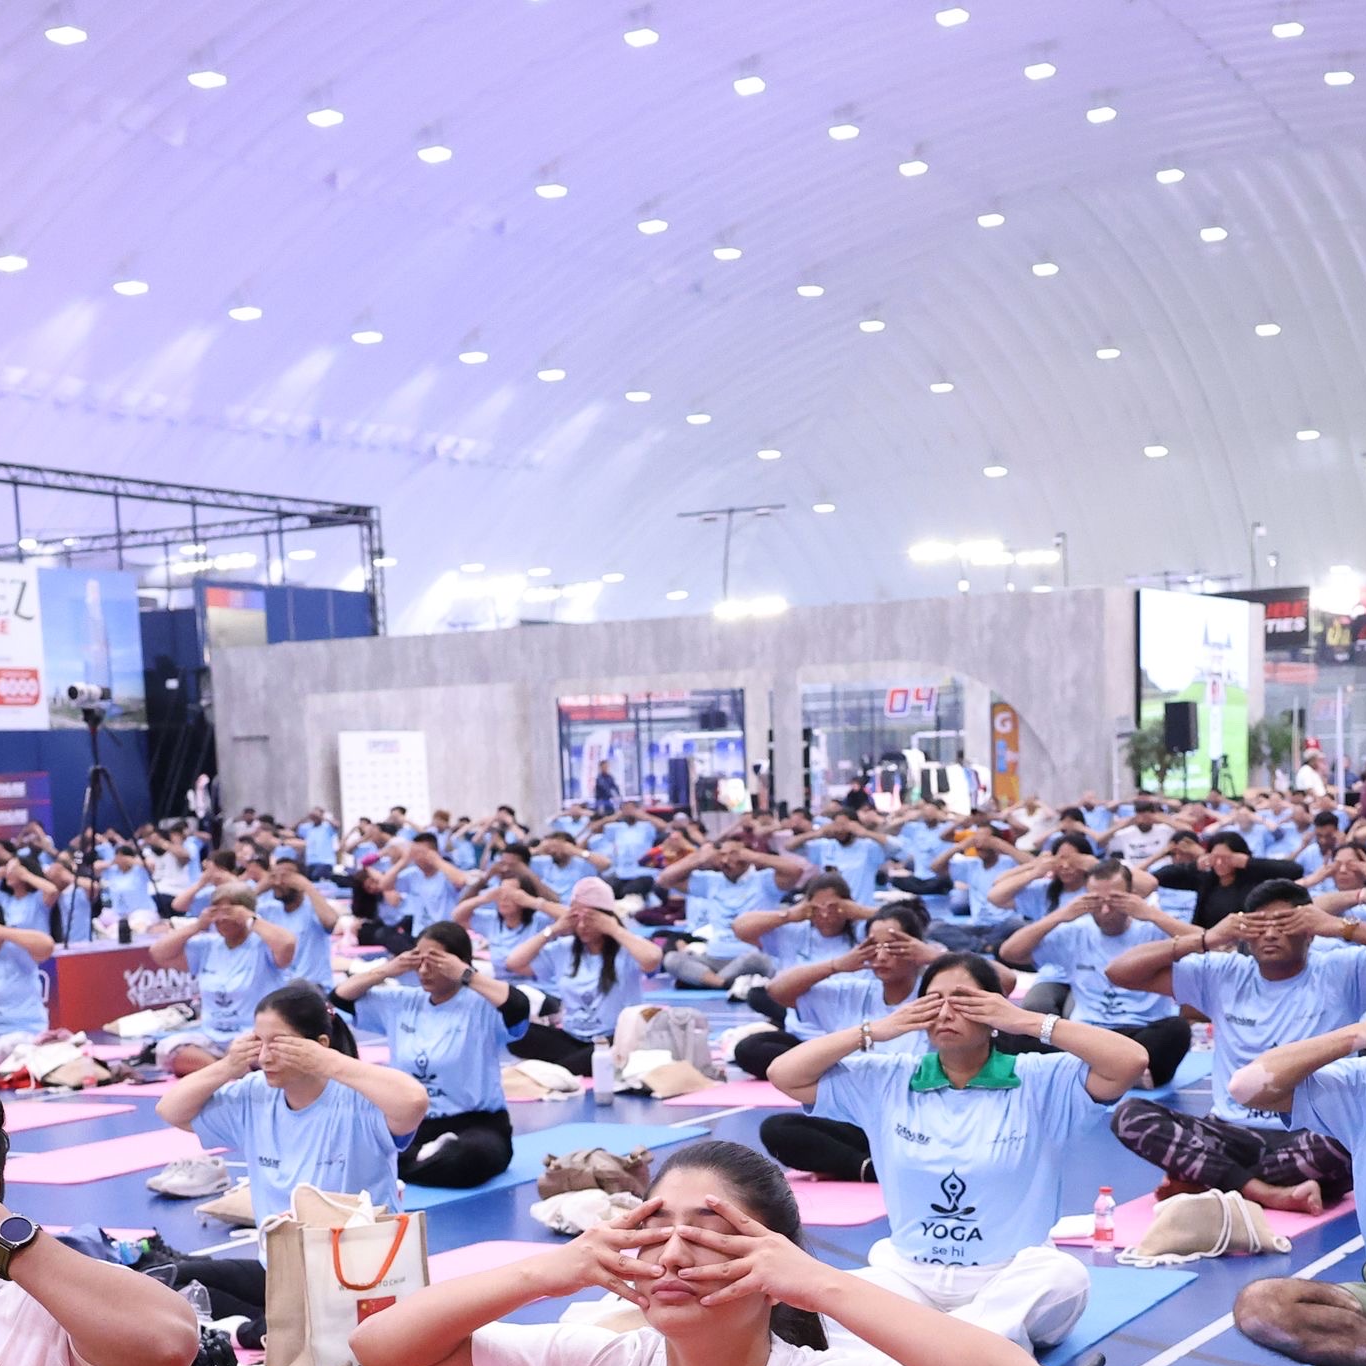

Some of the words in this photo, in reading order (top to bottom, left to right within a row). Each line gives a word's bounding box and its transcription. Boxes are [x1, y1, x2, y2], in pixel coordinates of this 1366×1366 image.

[1264, 616, 1307, 634] TIES
[886, 686, 937, 717] 04
[922, 1222, 983, 1241] YOGA
[932, 1246, 948, 1256] se
[951, 1244, 965, 1257] hi
